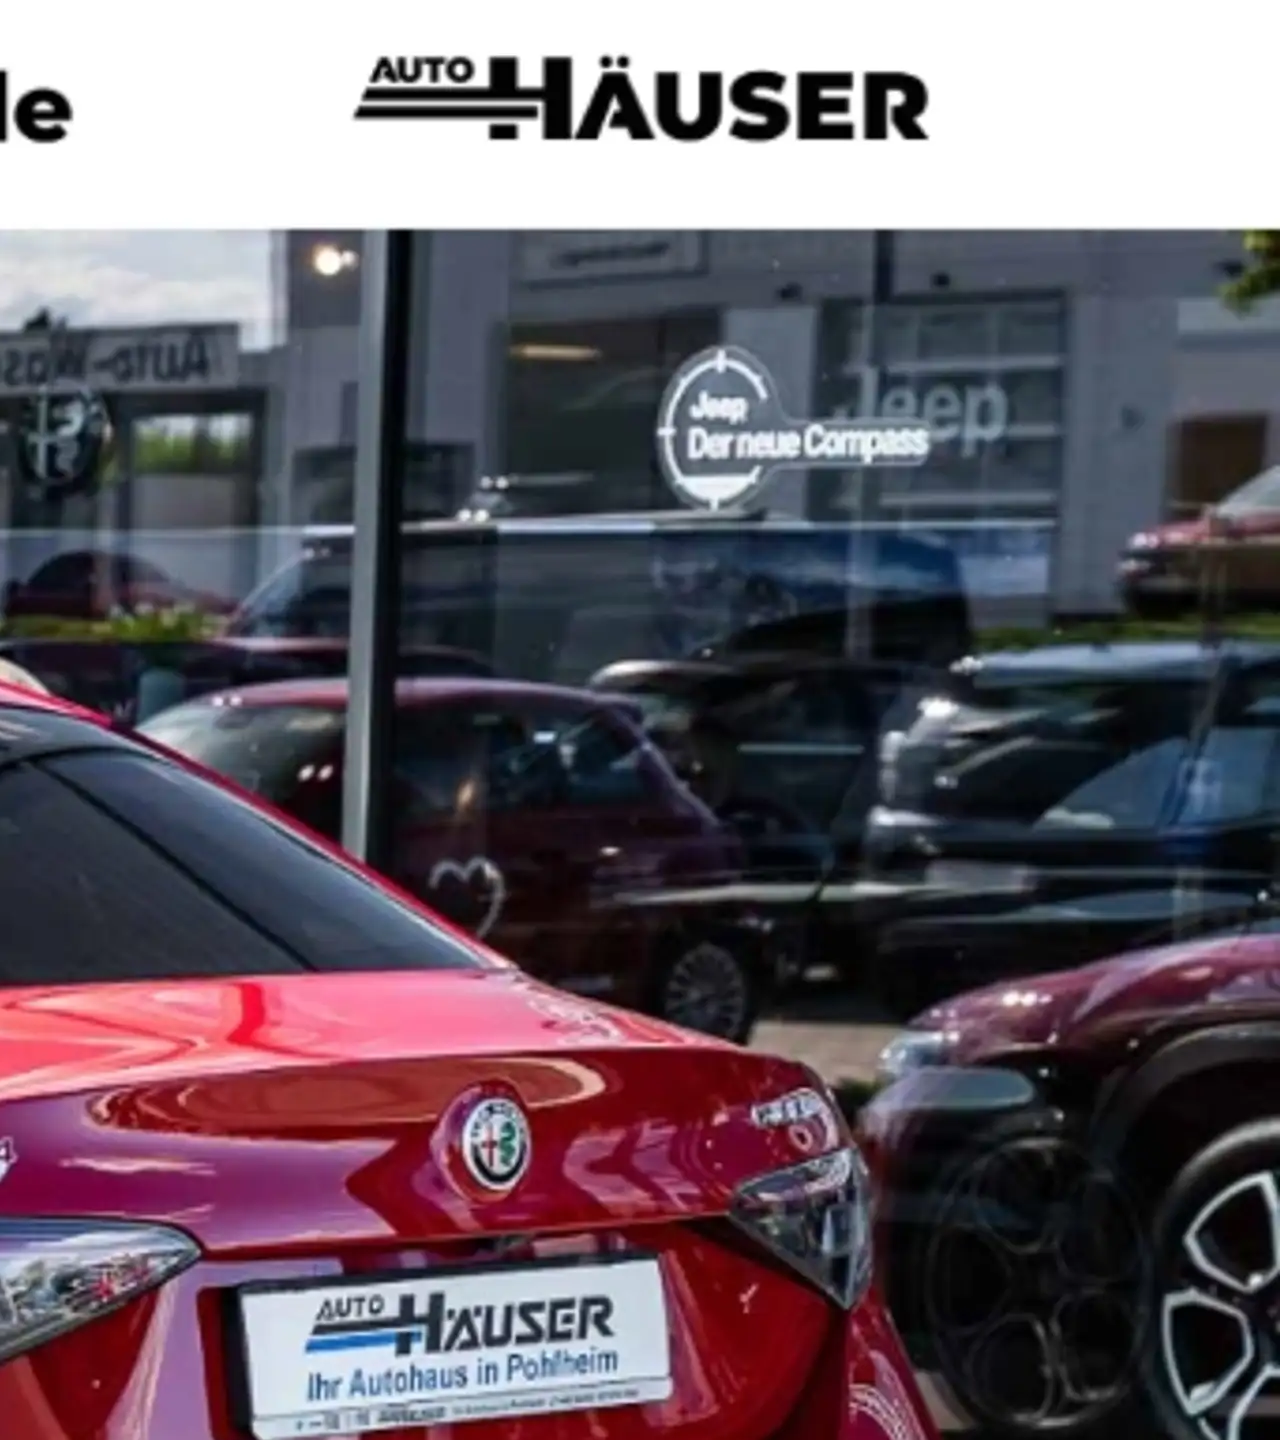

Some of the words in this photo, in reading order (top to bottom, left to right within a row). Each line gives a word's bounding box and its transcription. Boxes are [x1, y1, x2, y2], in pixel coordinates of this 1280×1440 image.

[690, 390, 748, 425] Jeep
[688, 427, 734, 459] Der
[736, 430, 801, 459] neue
[803, 423, 929, 463] Compass
[316, 1294, 384, 1320] AUTO
[395, 1292, 614, 1356] HÄUSER
[306, 1373, 343, 1401] Ihr
[348, 1362, 468, 1398] Autohaus
[477, 1356, 498, 1384] in
[506, 1346, 619, 1381] Pohlheim
